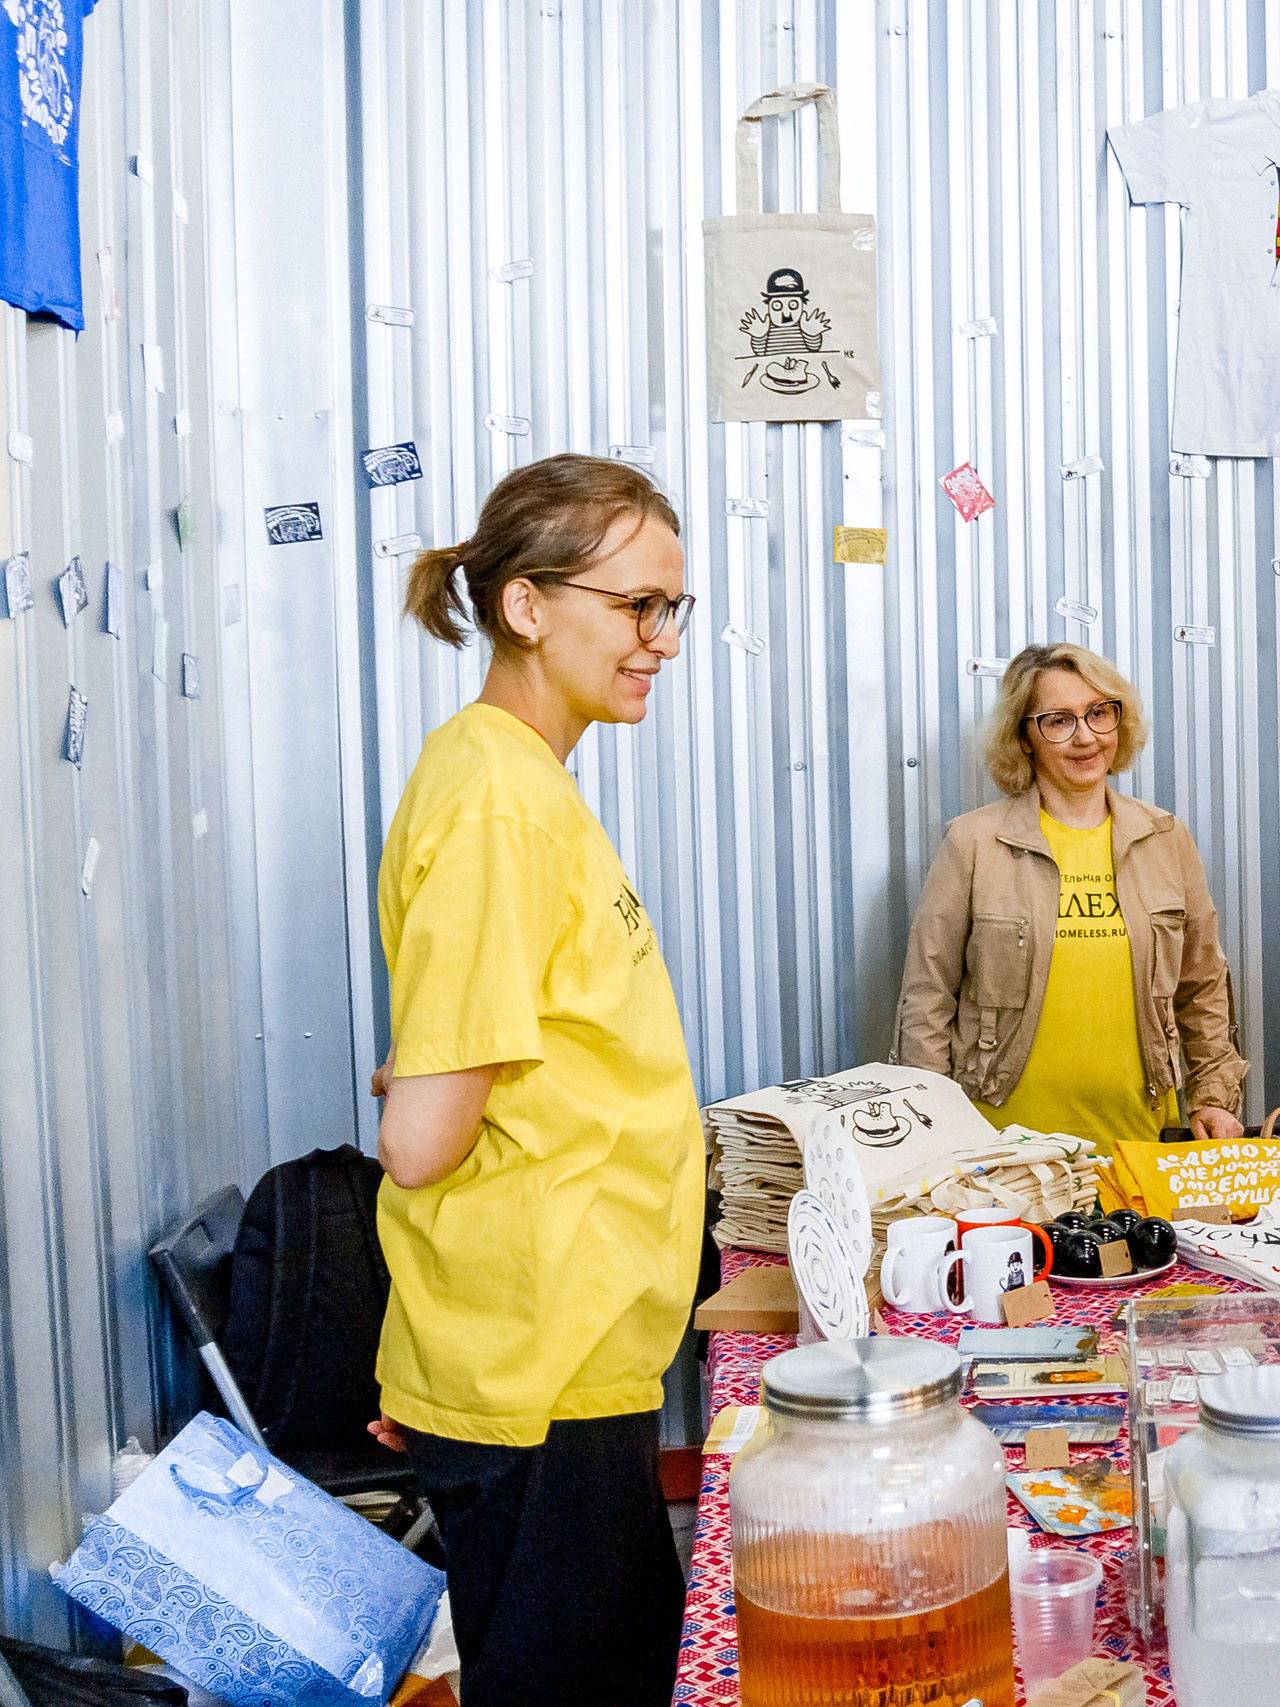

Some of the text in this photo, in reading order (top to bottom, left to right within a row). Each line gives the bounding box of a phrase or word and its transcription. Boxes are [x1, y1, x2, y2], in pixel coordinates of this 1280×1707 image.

[1061, 874, 1101, 883] ЕЛЬНАЯ
[1156, 1144, 1260, 1172] ДАВНО
[1179, 1167, 1209, 1180] НЕ
[1187, 1171, 1258, 1193] МОЕМ
